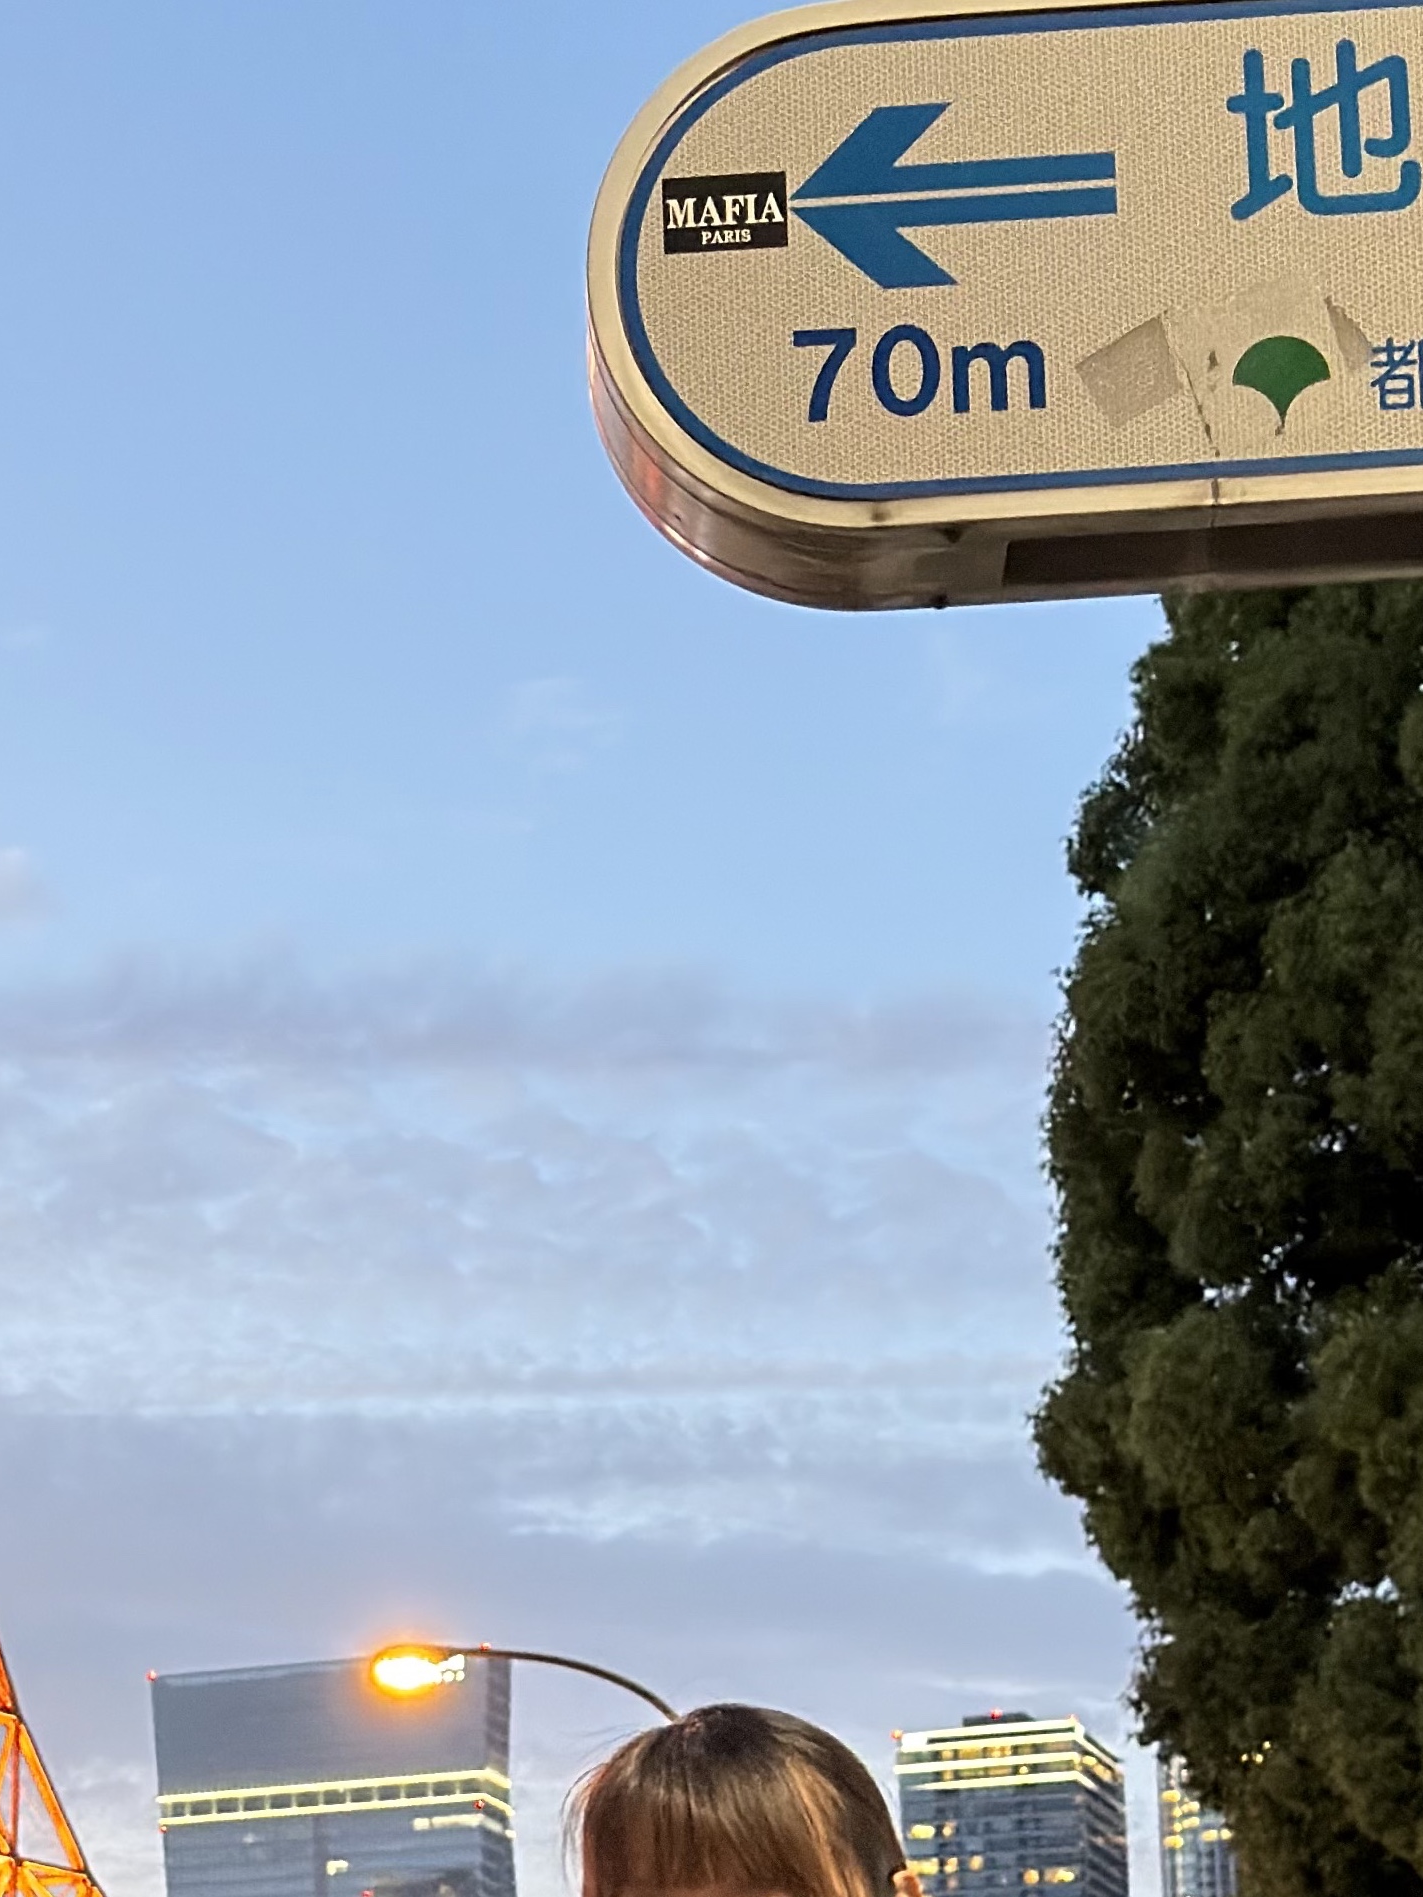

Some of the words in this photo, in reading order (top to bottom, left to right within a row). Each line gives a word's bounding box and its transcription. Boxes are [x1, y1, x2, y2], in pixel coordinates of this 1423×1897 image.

[665, 190, 784, 232] MAFIA
[701, 227, 752, 246] PARIS
[792, 324, 1048, 423] 70m
